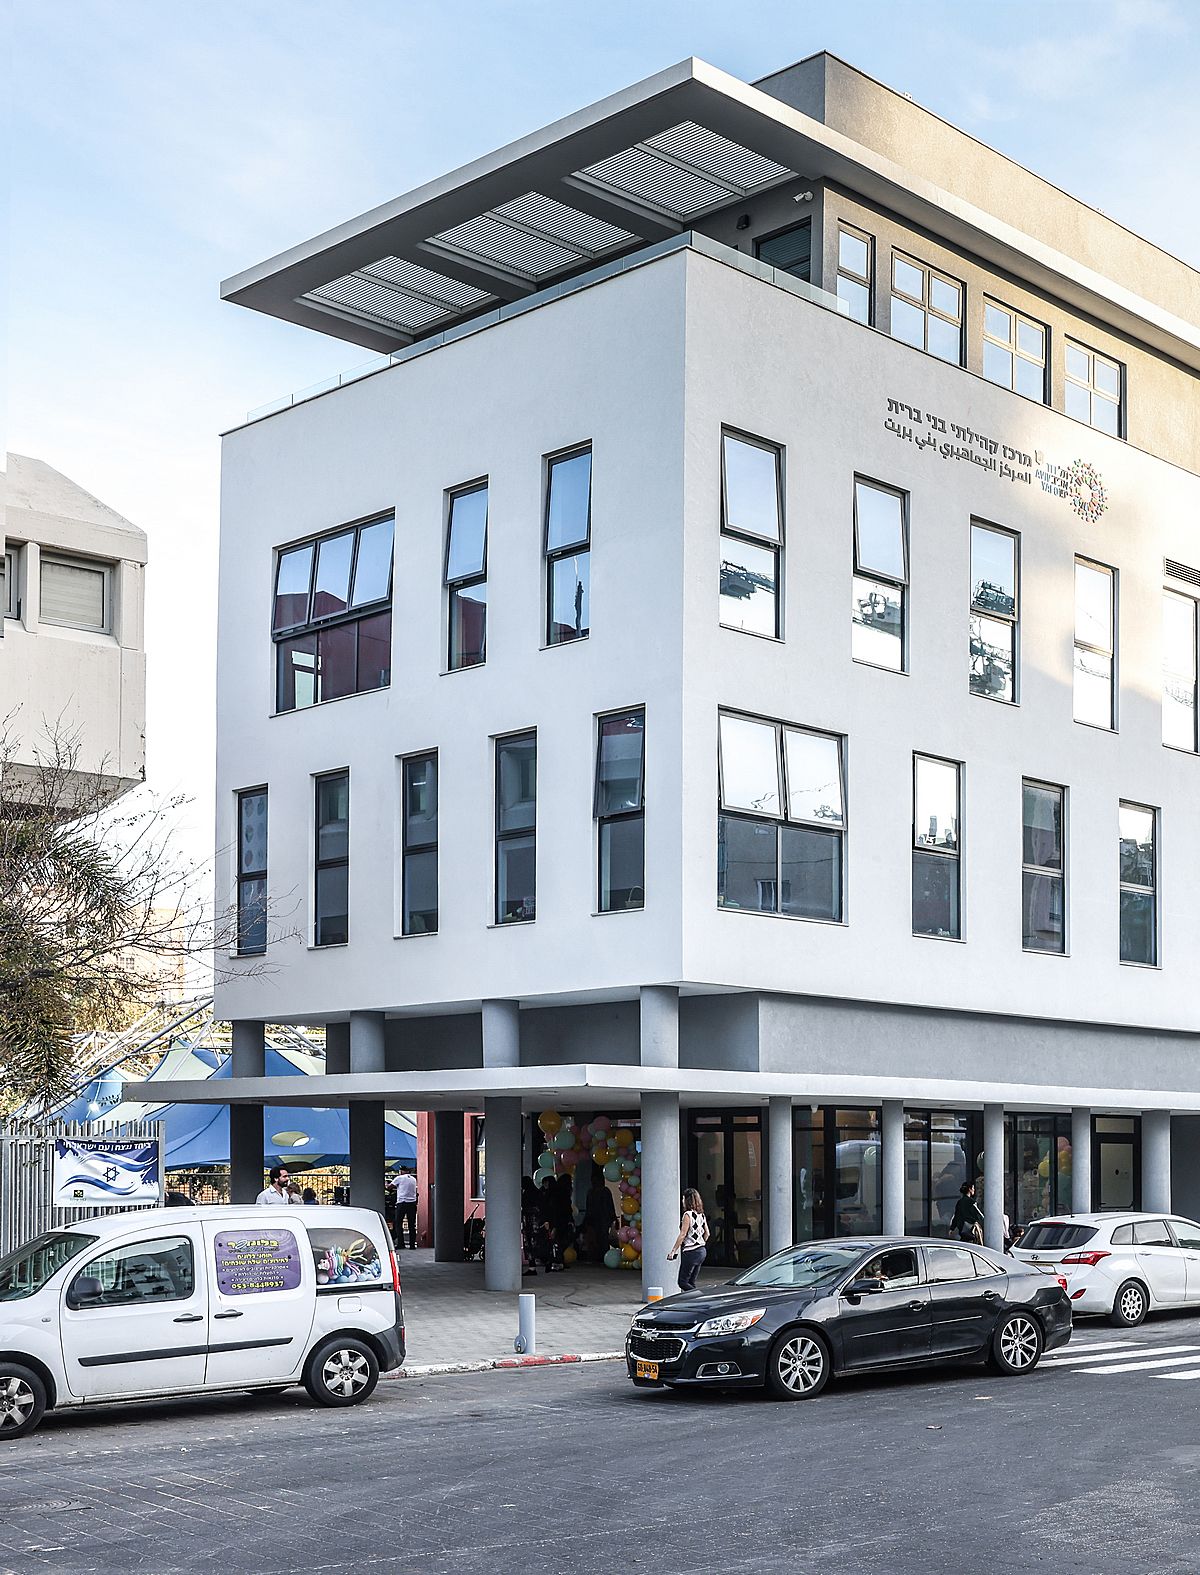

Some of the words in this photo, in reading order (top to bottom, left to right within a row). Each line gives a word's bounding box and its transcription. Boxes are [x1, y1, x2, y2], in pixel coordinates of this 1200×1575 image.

[887, 397, 922, 423] ברית
[884, 417, 912, 442] بريت
[926, 413, 947, 434] בני
[915, 431, 937, 452] بني
[951, 423, 999, 455] קהילתי
[940, 442, 997, 472] الجماهيري
[1002, 444, 1032, 467] מרכז
[1000, 460, 1031, 484] المركز
